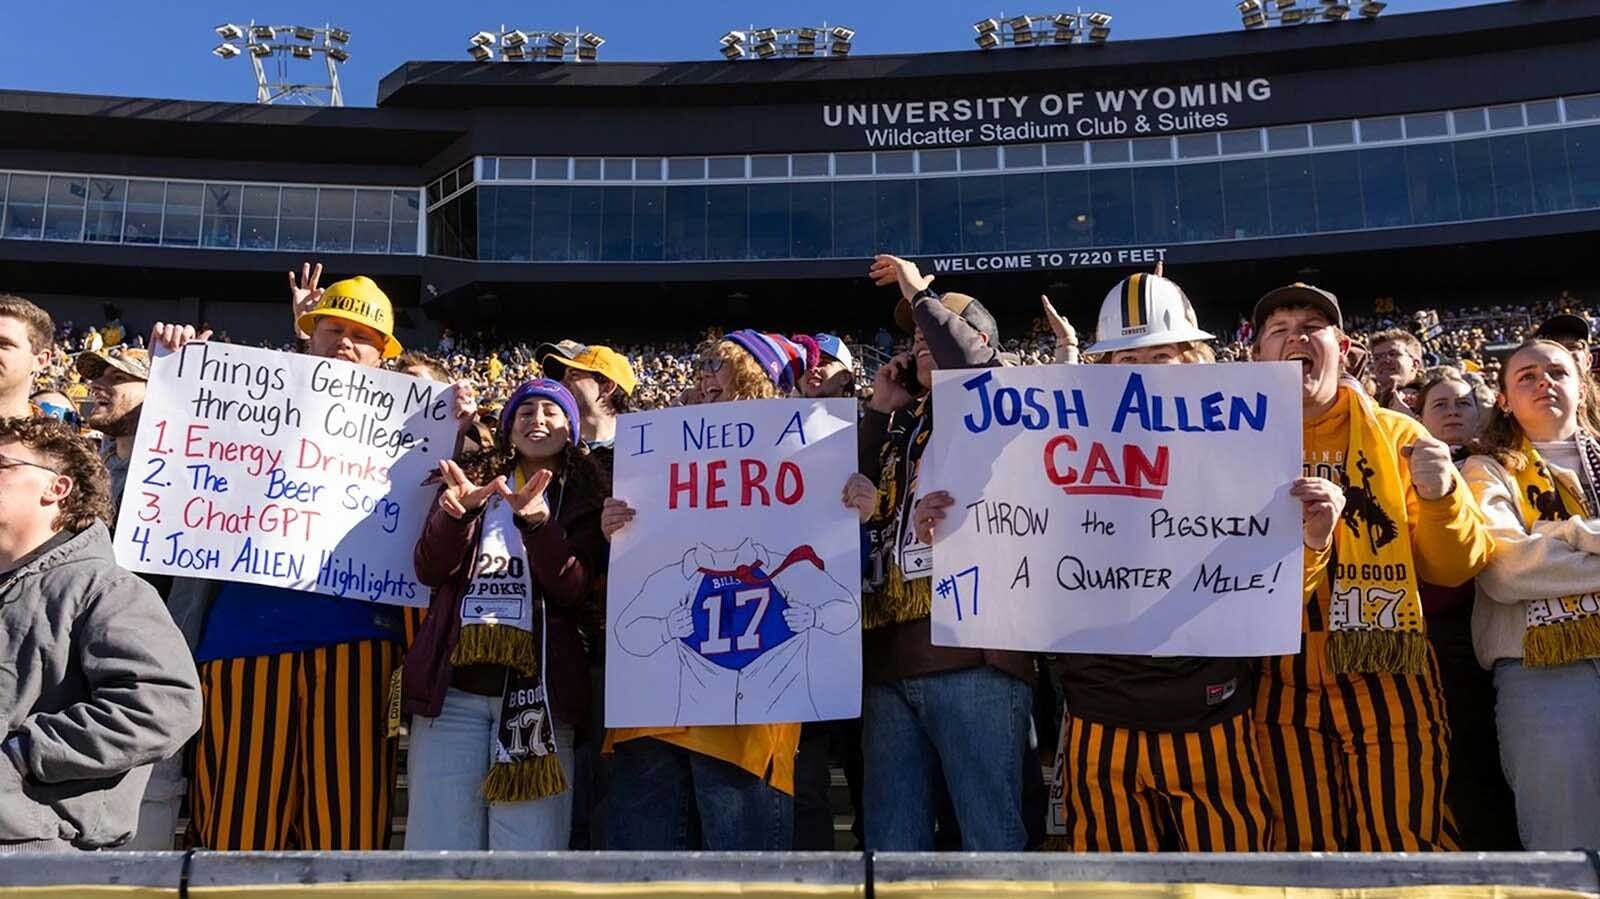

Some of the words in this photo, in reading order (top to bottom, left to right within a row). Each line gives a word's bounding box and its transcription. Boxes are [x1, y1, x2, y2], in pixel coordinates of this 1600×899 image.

[823, 96, 1028, 126] UNIVERSITY
[1040, 93, 1084, 115] OF
[1096, 78, 1270, 112] WYOMING
[865, 128, 973, 146] Wildcatter
[980, 121, 1068, 142] Stadium
[1076, 117, 1127, 136] Club
[1135, 115, 1151, 132] &
[1158, 112, 1229, 131] Suites
[934, 254, 1032, 271] WELCOME
[1038, 253, 1063, 267] TO
[1069, 251, 1112, 266] 7220
[1118, 249, 1167, 263] FEET
[178, 342, 285, 400] Things
[311, 361, 394, 420] Getting
[403, 382, 447, 421] Me
[963, 371, 1089, 434] JOSH
[1111, 372, 1268, 433] ALLEN
[192, 387, 301, 436] through
[324, 403, 429, 458] College:
[630, 423, 654, 456] I
[683, 417, 754, 451] NEED
[776, 411, 806, 446] A
[149, 420, 174, 455] 1.
[184, 425, 282, 476] Energy
[296, 438, 389, 485] Drinks
[1043, 434, 1170, 486] CAN
[1302, 450, 1343, 462] ING
[142, 458, 172, 487] 2.
[187, 464, 228, 493] The
[265, 468, 325, 502] Beer
[342, 485, 401, 533] Song
[668, 458, 804, 510] HERO
[137, 492, 162, 524] 3.
[183, 497, 321, 541] ChatGPT
[966, 500, 1049, 537] THROW
[1081, 509, 1116, 535] the
[1150, 508, 1270, 538] PIGSKIN
[131, 526, 152, 563] 4.
[162, 531, 220, 569] JOSH
[230, 537, 305, 580] ALLEN
[316, 549, 416, 601] Highlights
[1010, 556, 1031, 589] A
[1056, 556, 1172, 591] QUARTER
[1193, 562, 1282, 594] MILE!
[1361, 563, 1407, 581] GOOD
[477, 583, 527, 598] POKES
[936, 566, 979, 621] #17
[1336, 586, 1407, 630] 17
[700, 587, 770, 655] 17
[506, 707, 545, 758] 17
